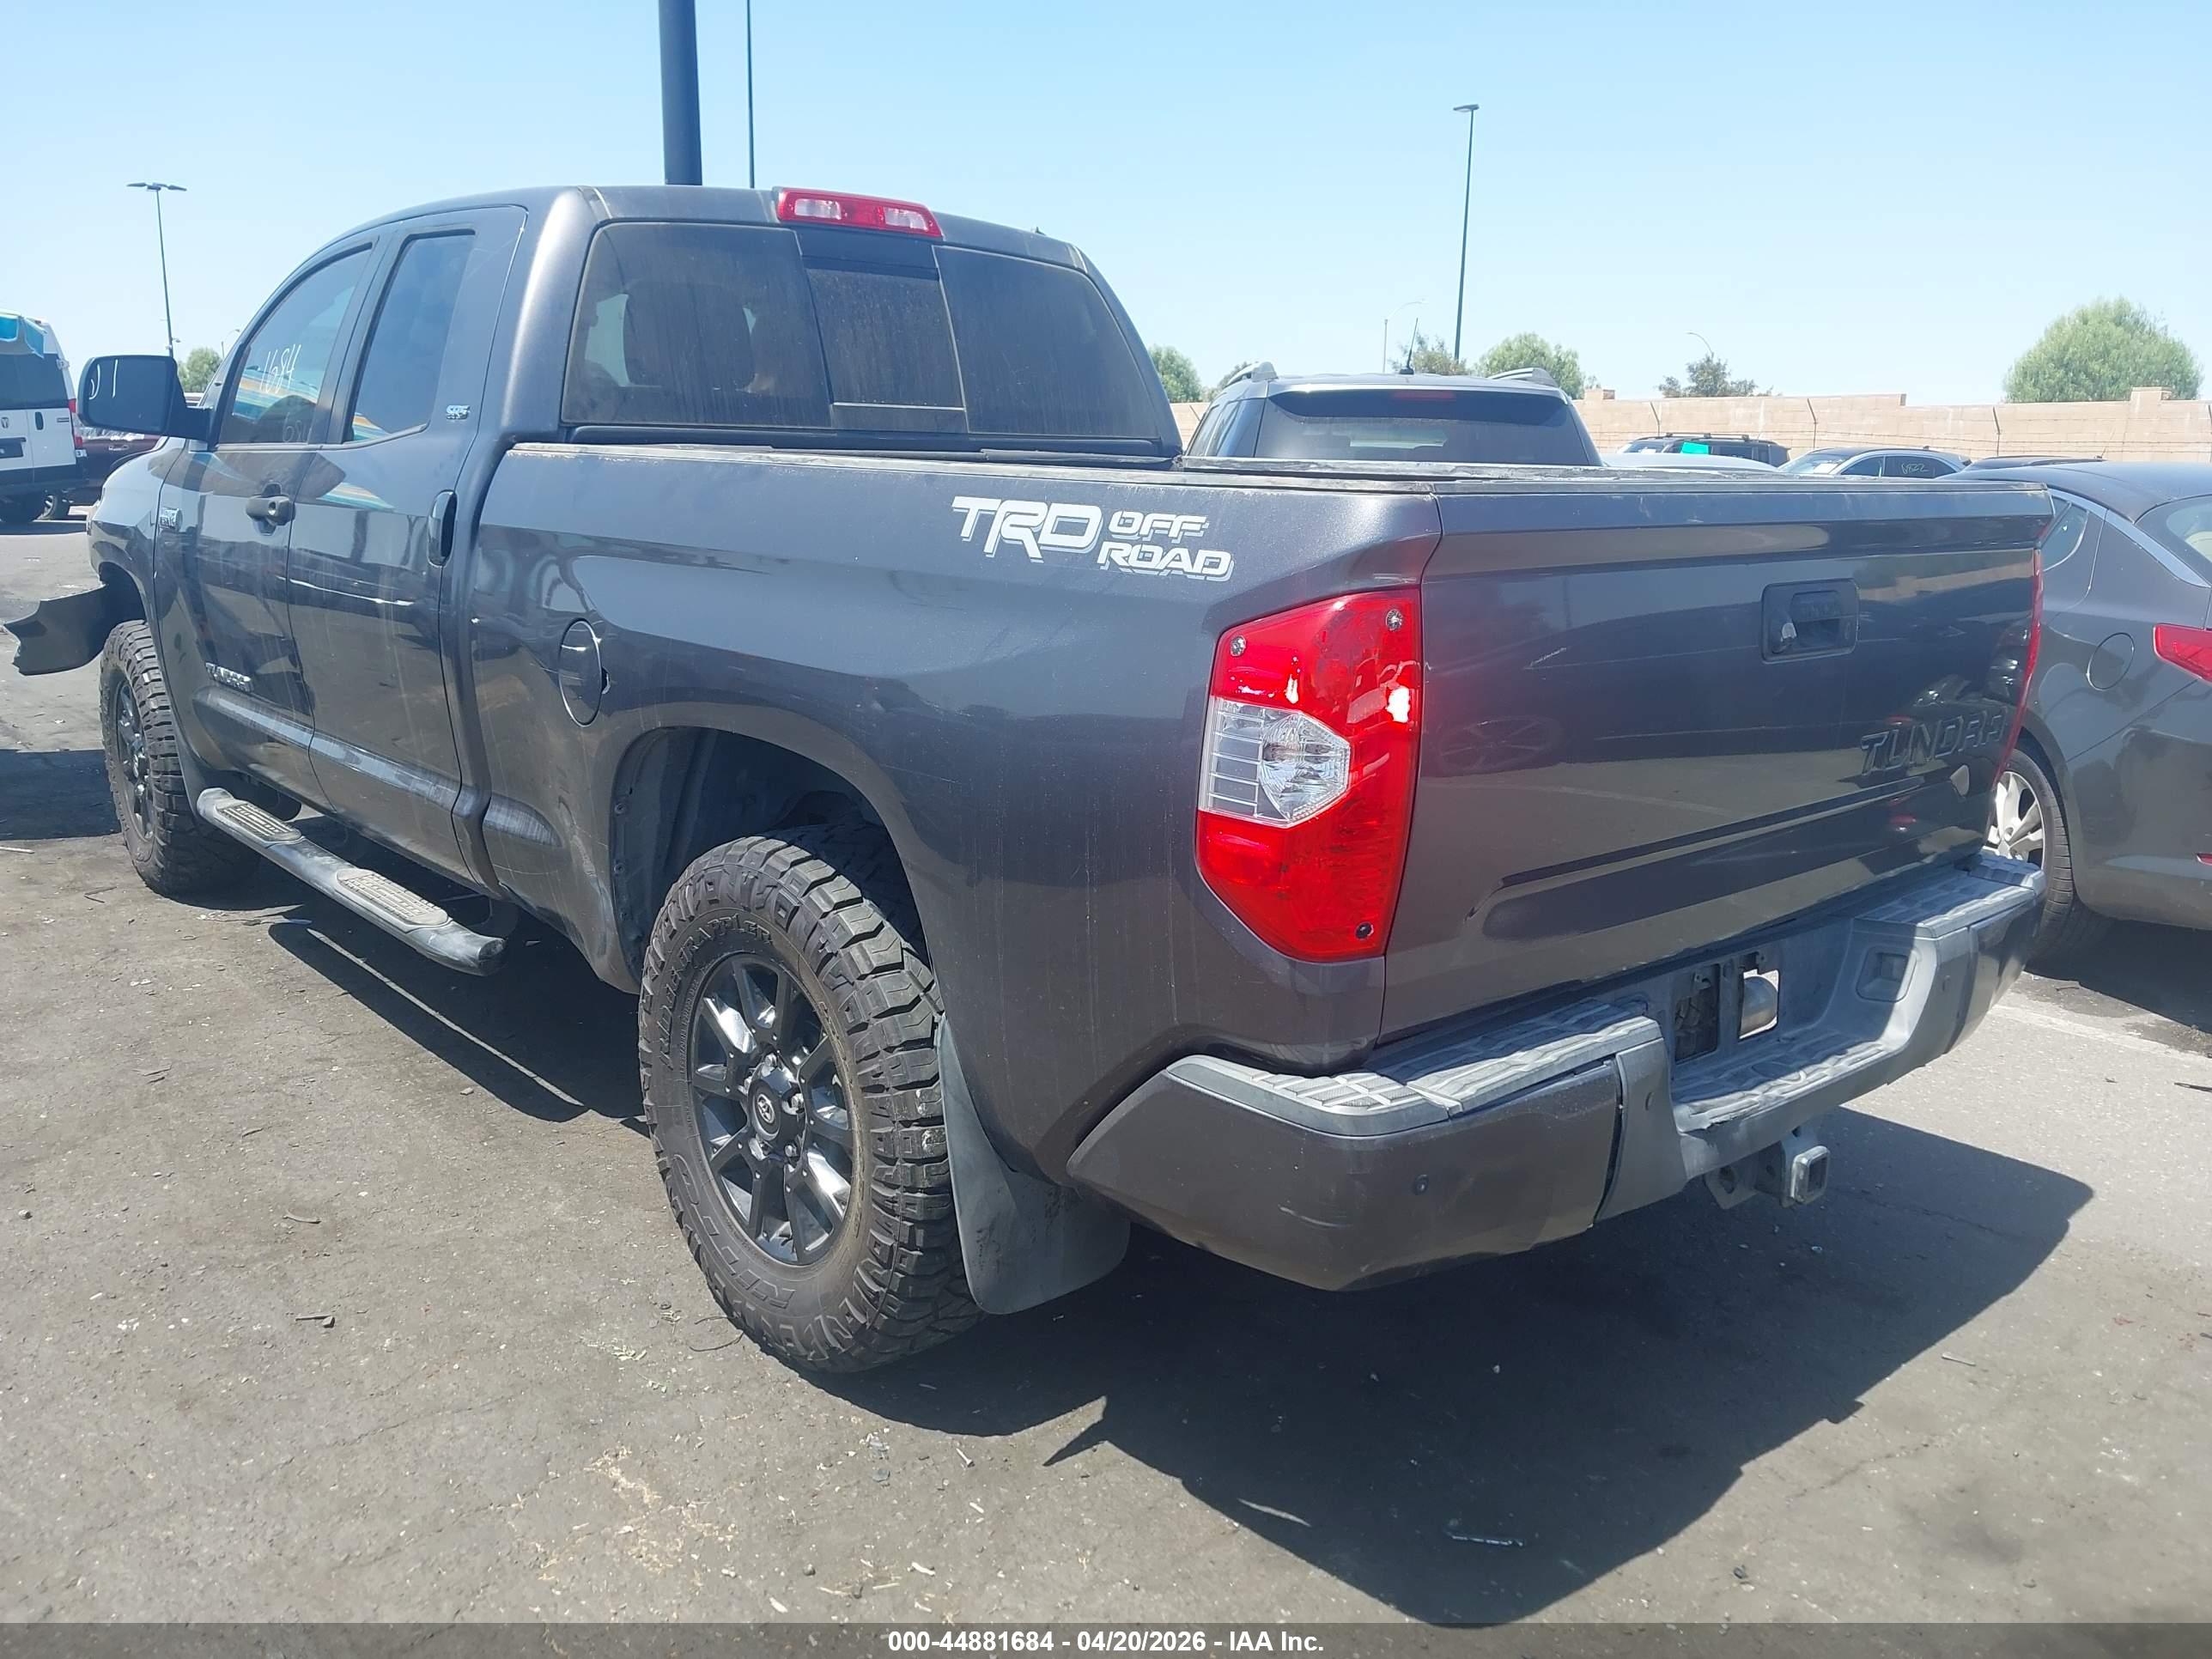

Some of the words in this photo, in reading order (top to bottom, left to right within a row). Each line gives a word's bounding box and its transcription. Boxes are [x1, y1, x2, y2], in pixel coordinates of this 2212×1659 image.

[951, 495, 1104, 563] TRD
[1108, 510, 1210, 544] OFF
[1097, 541, 1235, 582] ROAD
[1860, 705, 2009, 776] TUNDRA
